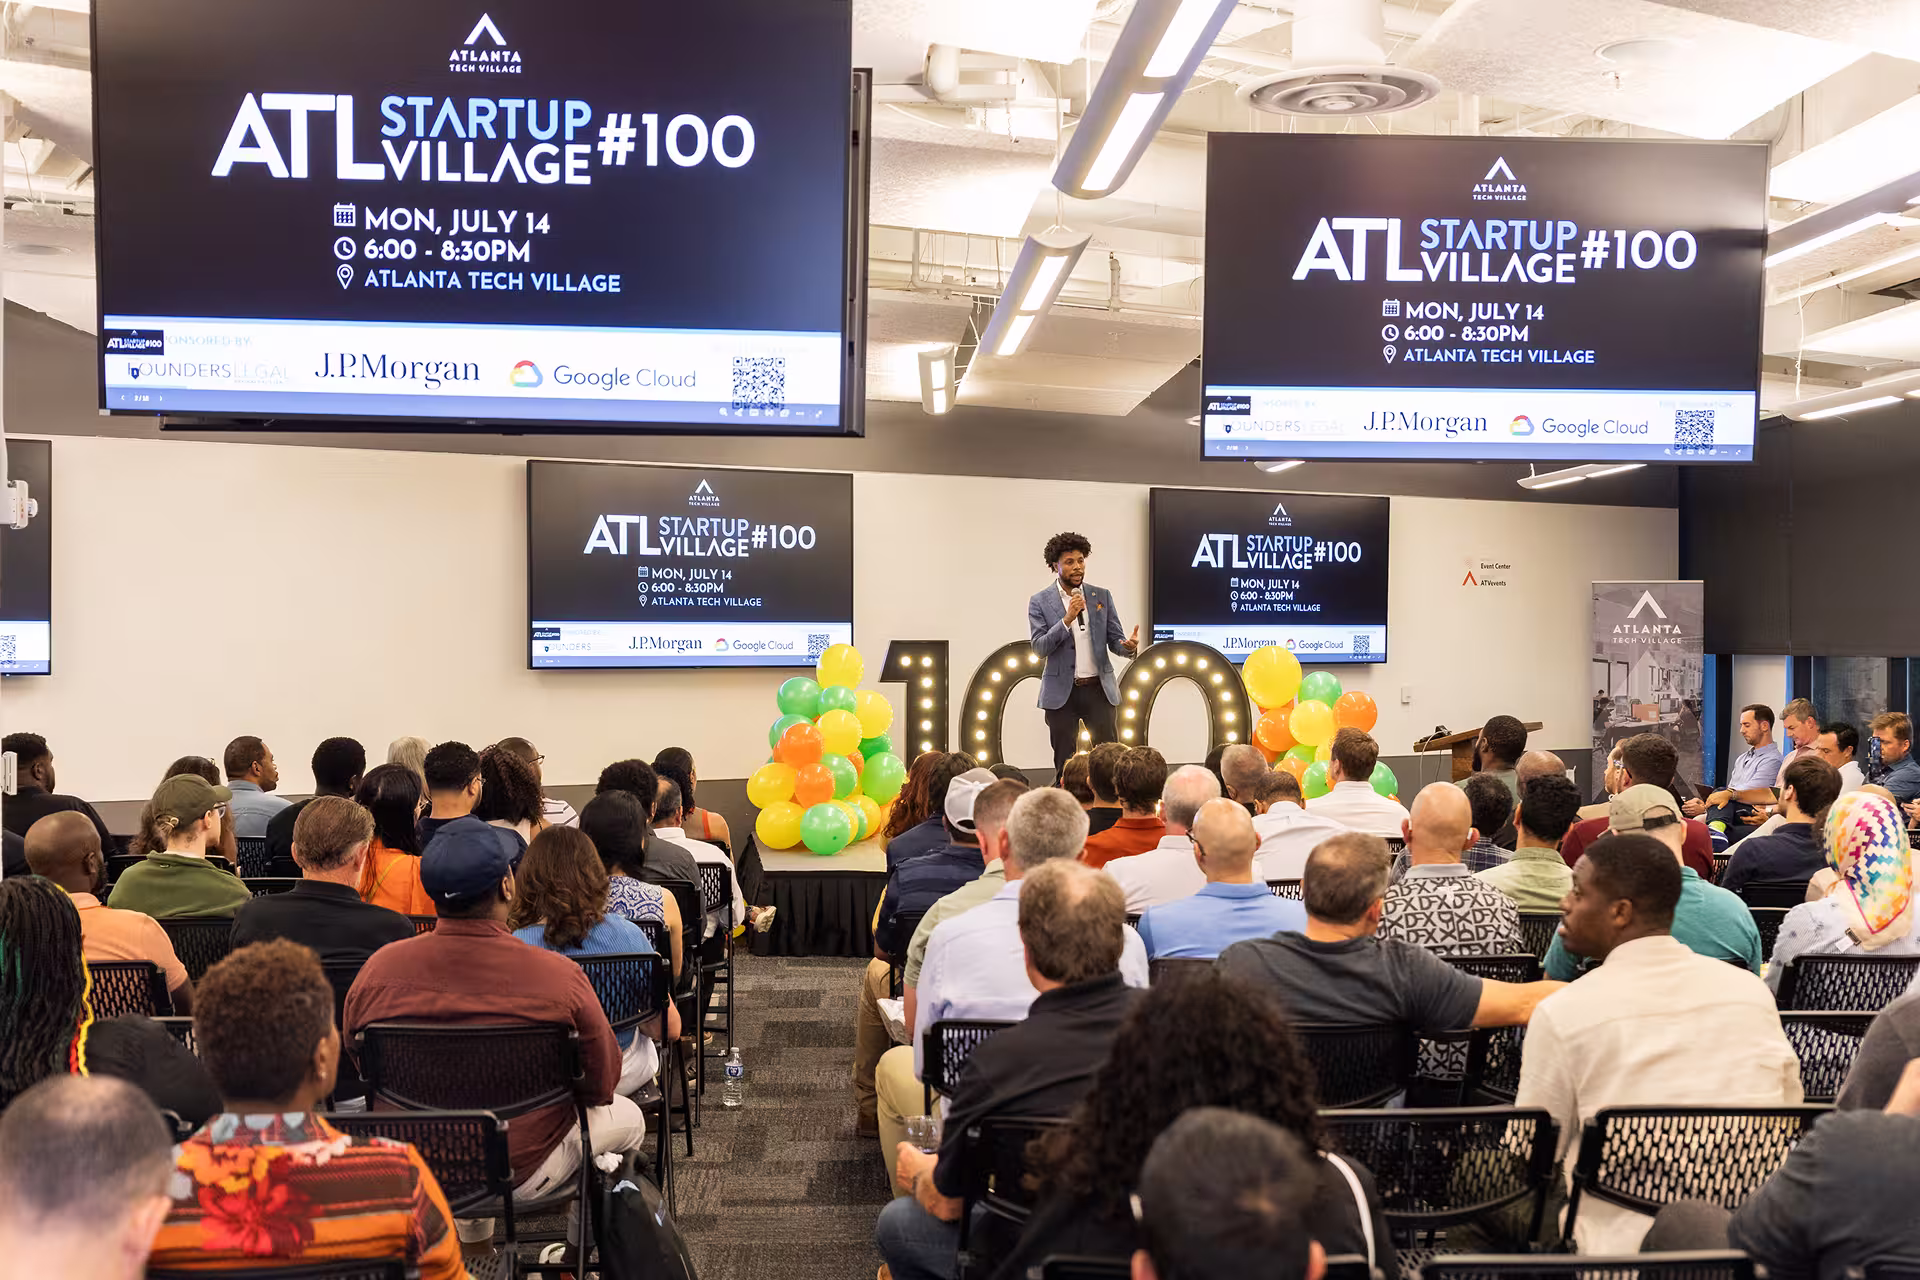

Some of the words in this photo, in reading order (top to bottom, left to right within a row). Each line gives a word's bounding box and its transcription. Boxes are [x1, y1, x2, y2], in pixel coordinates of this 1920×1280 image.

[449, 49, 522, 63] ATLANTA
[449, 63, 475, 73] TECH
[479, 64, 522, 74] VILLAGE
[210, 92, 386, 181] ATL
[380, 95, 592, 141] STARTUP
[597, 113, 755, 168] #100
[381, 139, 592, 185] VILLAGE
[1472, 183, 1527, 193] ATLANTA
[365, 206, 442, 235] MON,
[449, 208, 517, 236] JULY
[526, 212, 550, 234] 14
[364, 238, 417, 260] 6:00
[440, 239, 530, 262] 8:30PM
[1292, 217, 1423, 281] ATL
[1420, 218, 1578, 251] STARTUP
[1580, 229, 1698, 270] #100
[1420, 251, 1577, 283] VILLAGE
[364, 269, 462, 290] ATLANTA
[468, 271, 523, 290] TECH
[530, 272, 621, 293] VILLAGE
[1406, 302, 1464, 322] MON,
[1468, 302, 1521, 322] JULY
[1525, 304, 1545, 320] 14
[1404, 325, 1444, 341] 6:00
[1461, 325, 1529, 342] 8:30PM
[1404, 348, 1477, 363] ATLANTA
[1481, 349, 1523, 363] TECH
[1528, 350, 1596, 364] VILLAGE
[314, 352, 480, 389] J.P.Morgan
[554, 365, 631, 392] Google
[635, 368, 697, 388] Cloud
[1363, 411, 1487, 438] J.P.Morgan
[1542, 418, 1600, 438] Google
[1603, 419, 1648, 434] Cloud
[583, 514, 661, 556] ATL
[659, 516, 749, 538] STARTUP
[751, 524, 816, 550] #100
[659, 536, 749, 558] VILLAGE
[1191, 533, 1249, 568] ATL
[1246, 535, 1313, 552] STARTUP
[1314, 541, 1362, 563] #100
[1247, 551, 1313, 570] VILLAGE
[651, 568, 686, 581] MON,
[686, 569, 719, 582] JULY
[721, 569, 732, 580] 14
[1240, 579, 1266, 590] MON,
[1267, 579, 1290, 590] JULY
[1291, 580, 1300, 589] 14
[651, 583, 675, 593] 6:00
[685, 582, 724, 594] 8:30PM
[1240, 591, 1258, 600] 6:00
[1264, 591, 1294, 601] 8:30PM
[651, 597, 694, 606] ATLANTA
[697, 597, 721, 606] TECH
[724, 597, 762, 607] VILLAGE
[1240, 603, 1271, 611] ATLANTA
[1273, 603, 1291, 612] TECH
[1292, 603, 1321, 612] VILLAGE
[1613, 624, 1682, 634] ATLANTA
[628, 635, 702, 653] J.P.Morgan
[733, 639, 766, 652] Google
[767, 639, 794, 651] Cloud
[1298, 640, 1324, 650] Google
[1324, 640, 1344, 650] Cloud
